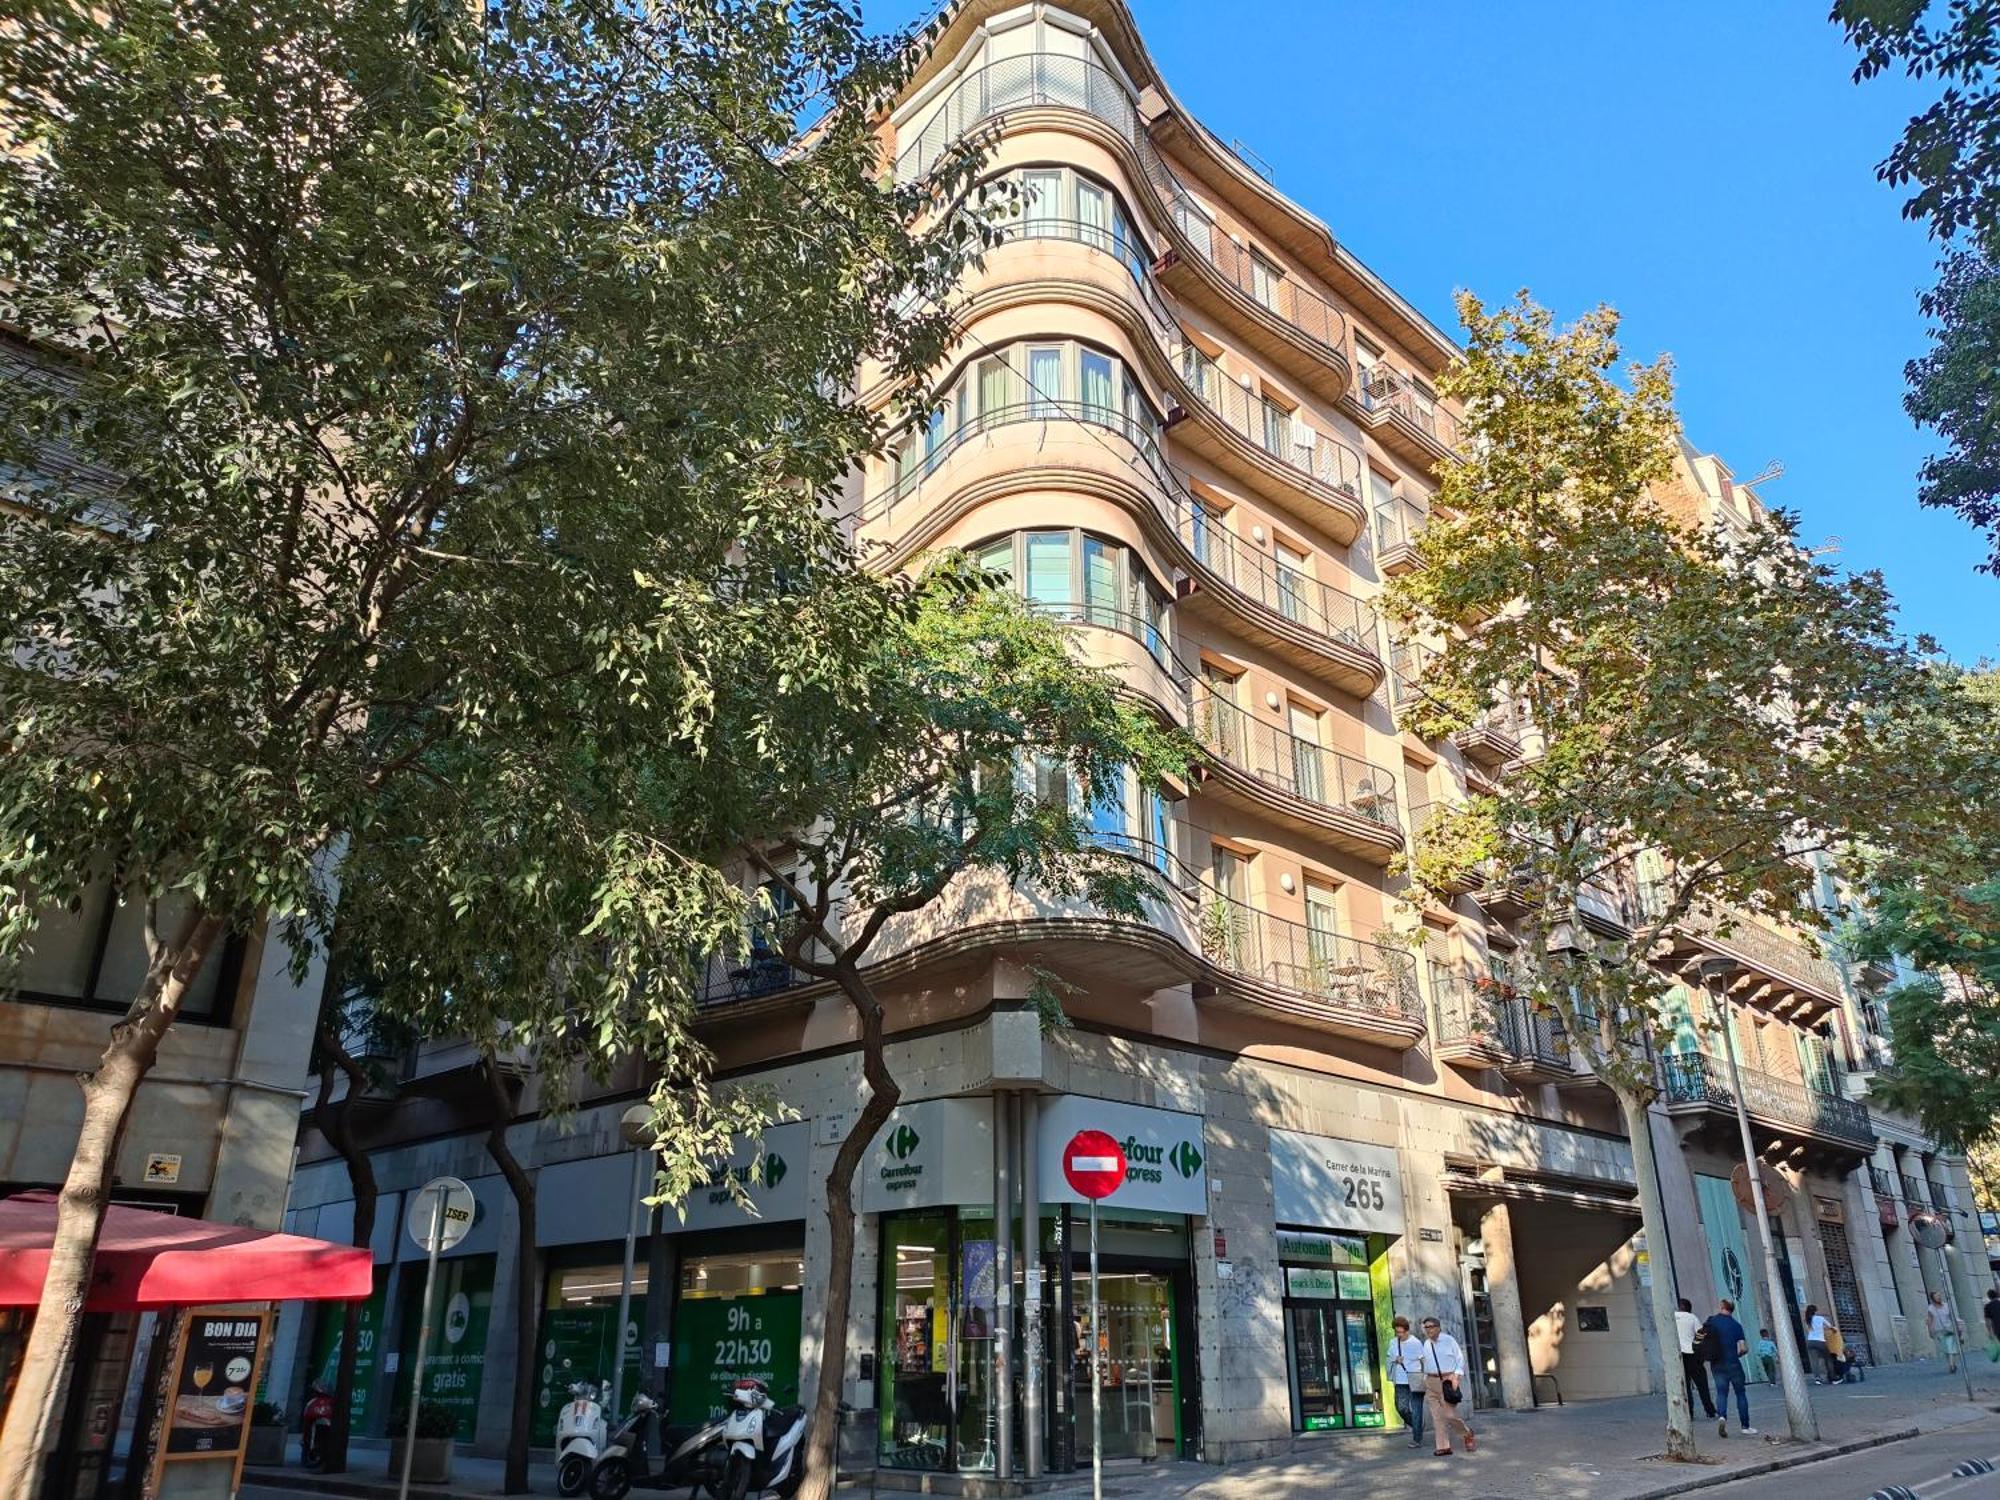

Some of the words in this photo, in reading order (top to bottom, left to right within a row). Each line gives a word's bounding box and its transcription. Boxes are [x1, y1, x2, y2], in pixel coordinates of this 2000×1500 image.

[881, 1164, 922, 1178] Carrefour
[1326, 1160, 1348, 1172] Carrer
[1349, 1164, 1359, 1173] de
[1360, 1164, 1366, 1175] la
[1368, 1166, 1391, 1178] Marina
[886, 1180, 916, 1191] express
[1343, 1177, 1384, 1211] 265
[204, 1322, 233, 1337] BON
[234, 1322, 258, 1337] DIA
[728, 1306, 750, 1332] 9h
[755, 1317, 762, 1330] a
[715, 1339, 772, 1365] 22h30
[433, 1368, 467, 1393] gratis
